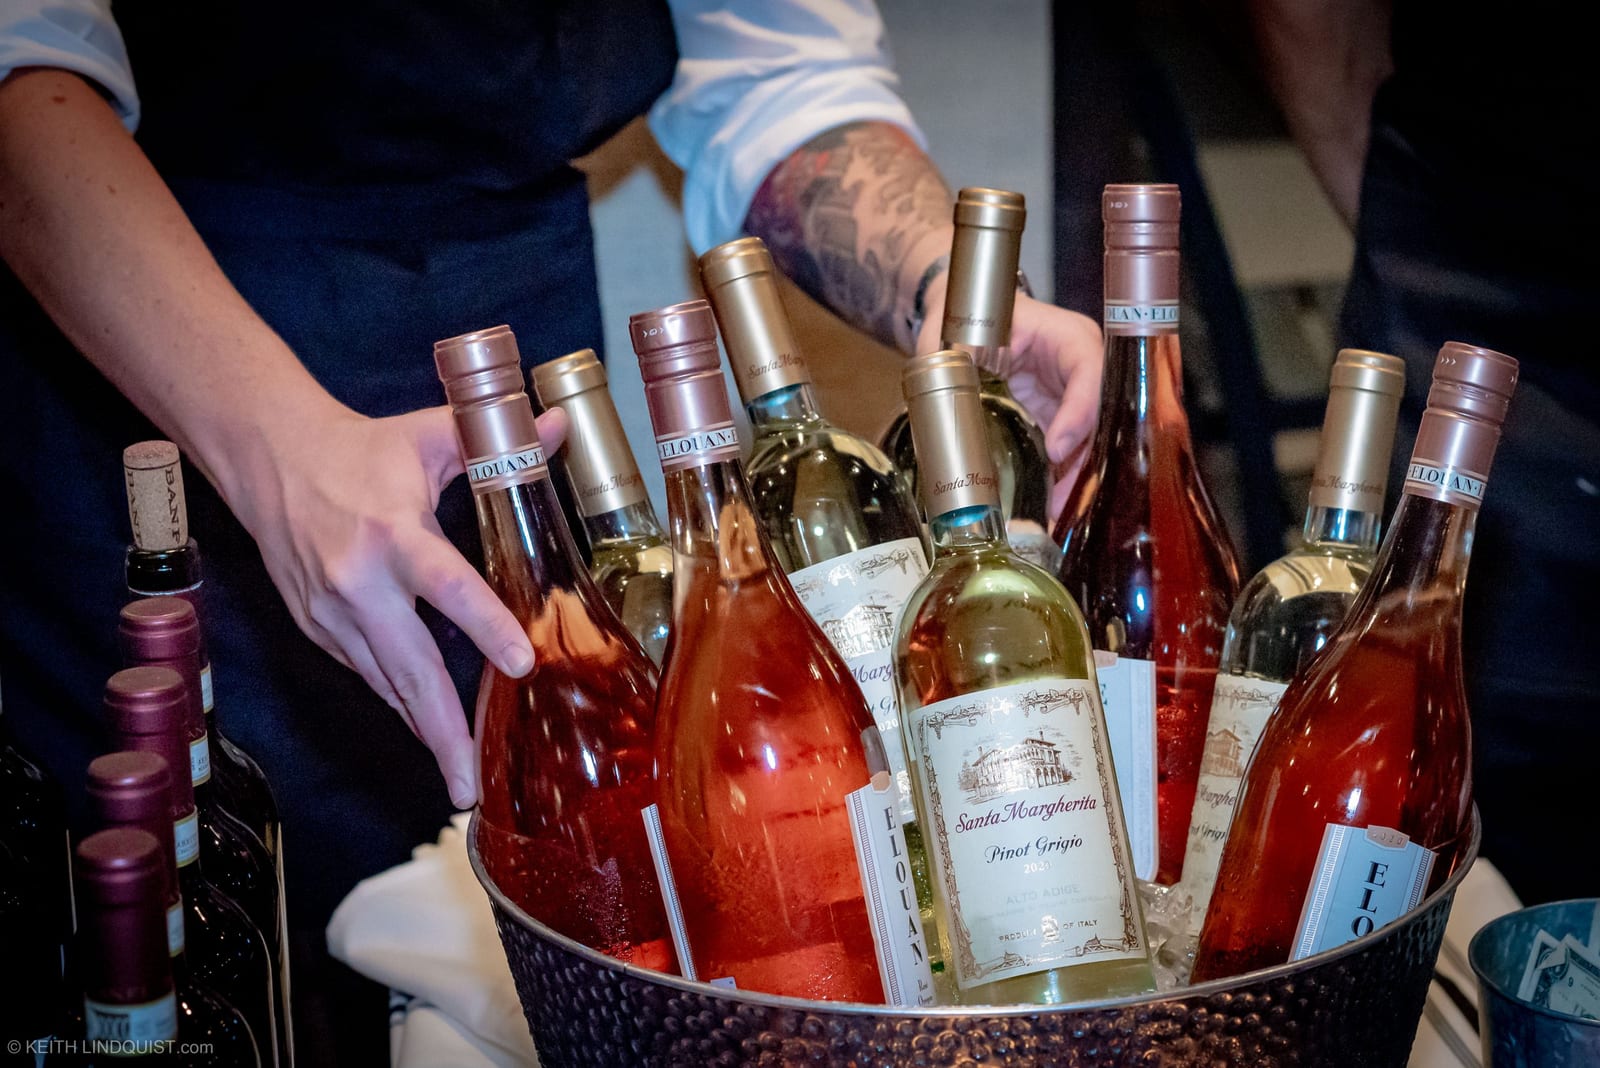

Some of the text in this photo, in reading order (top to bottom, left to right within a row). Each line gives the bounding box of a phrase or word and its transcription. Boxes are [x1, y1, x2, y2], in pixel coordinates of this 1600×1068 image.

[933, 476, 964, 496] Santa
[165, 466, 182, 545] BANF
[851, 664, 893, 684] Marg
[878, 718, 899, 732] 020
[1198, 784, 1237, 809] Marghe
[955, 794, 1097, 834] Santa Margherita
[984, 834, 1083, 864] Pinot Grigio
[884, 805, 924, 967] ELOUAN
[1006, 889, 1038, 905] ALTO
[1043, 883, 1081, 899] ADIGE
[1350, 860, 1389, 939] ELO
[1062, 922, 1074, 932] OF
[1077, 919, 1099, 929] ITALY
